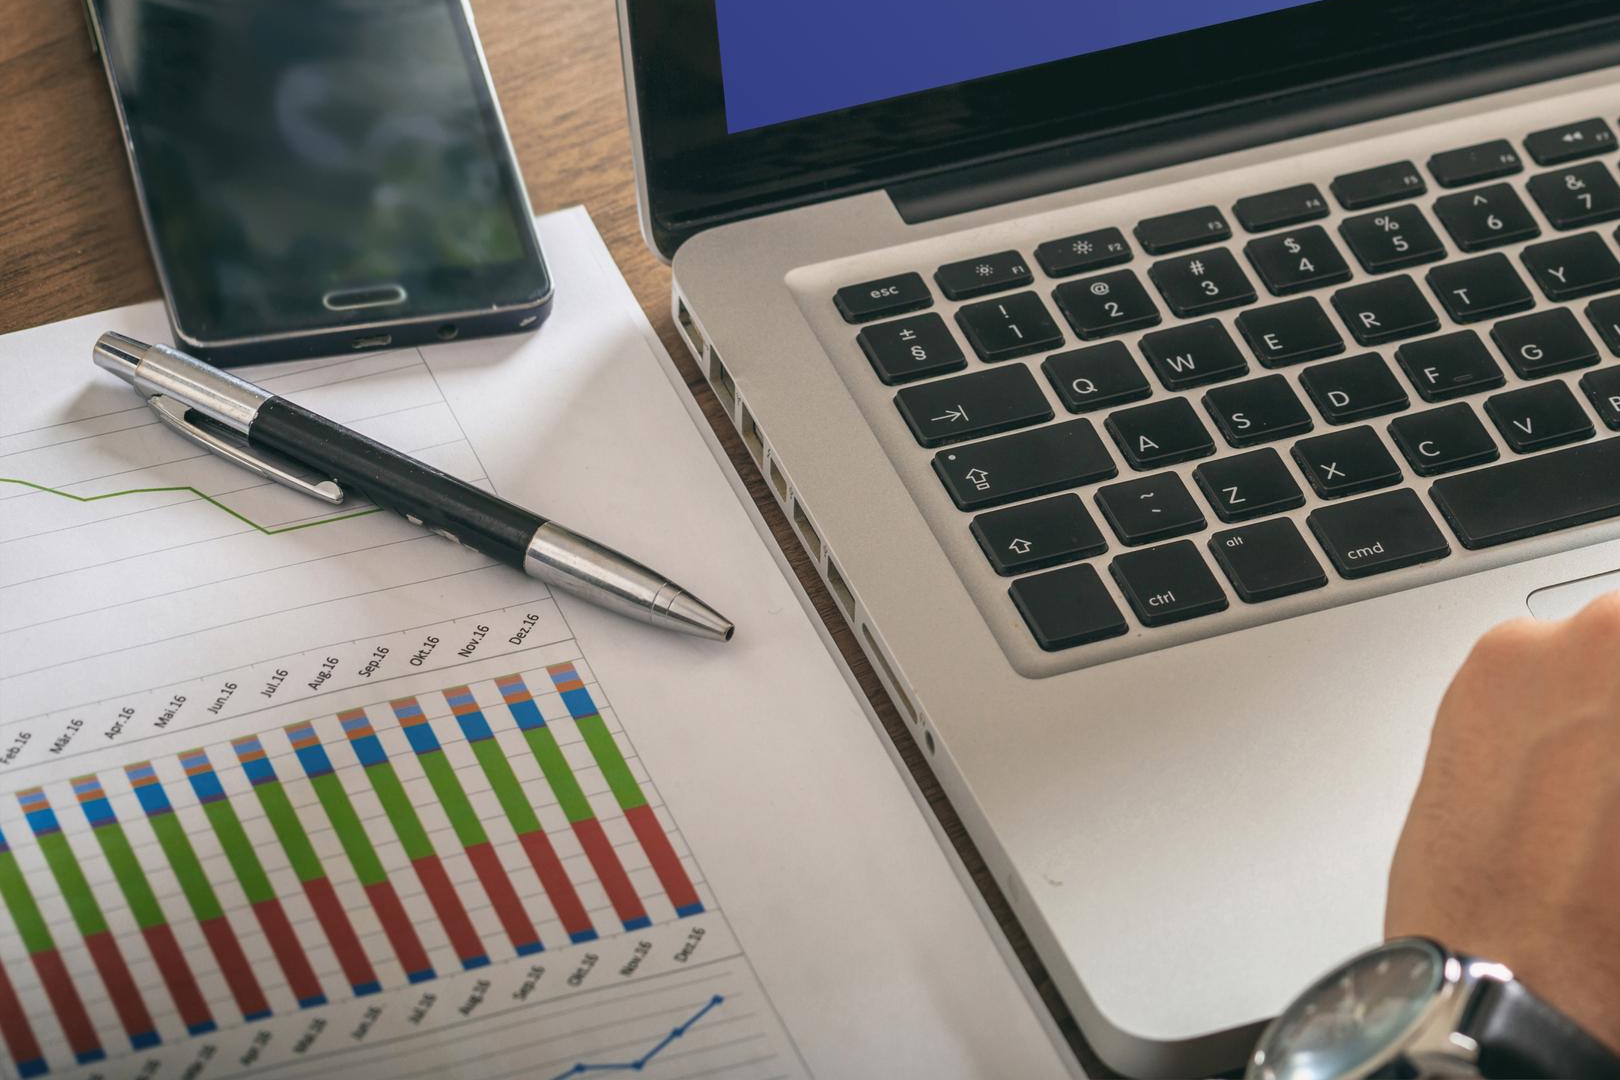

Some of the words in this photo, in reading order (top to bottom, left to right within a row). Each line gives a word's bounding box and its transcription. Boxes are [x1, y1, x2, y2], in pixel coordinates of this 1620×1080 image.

[1500, 154, 1515, 163] F6
[1403, 175, 1418, 186] F5
[1305, 199, 1321, 209] F4
[1577, 193, 1592, 209] 7
[1208, 221, 1223, 230] F3
[1374, 215, 1400, 232] %
[1487, 214, 1503, 230] 6
[1107, 242, 1123, 253] F2
[1283, 237, 1301, 254] $
[1392, 235, 1409, 252] 5
[1011, 265, 1025, 275] F1
[1299, 257, 1315, 272] 4
[1548, 266, 1566, 283] Y
[870, 283, 899, 299] esc
[1090, 281, 1110, 296] @
[1201, 280, 1219, 296] 3
[1453, 288, 1471, 305] T
[1104, 301, 1124, 317] 2
[1358, 311, 1381, 328] R
[1008, 324, 1024, 339] 1
[1263, 333, 1283, 350] E
[1520, 344, 1544, 361] G
[1166, 353, 1195, 373] W
[1423, 367, 1439, 384] F
[1072, 378, 1098, 394] Q
[1327, 390, 1350, 407] D
[1231, 412, 1251, 429] S
[1512, 417, 1532, 434] V
[1139, 435, 1160, 452] A
[1418, 440, 1441, 457] C
[1320, 462, 1345, 481] X
[1222, 486, 1246, 504] Z
[1225, 535, 1244, 547] alt
[1347, 541, 1385, 560] cmd
[1148, 590, 1176, 606] ctrl
[508, 613, 540, 646] Dez.16
[457, 624, 490, 658] Nov.16
[409, 635, 440, 667] Okt.16
[358, 646, 390, 678] Sep.16
[307, 656, 340, 691] Aug.16
[260, 668, 289, 698] Jul.16
[207, 682, 238, 715] Jun.16
[153, 695, 187, 729] Mai.16
[104, 707, 136, 740] Apr.16
